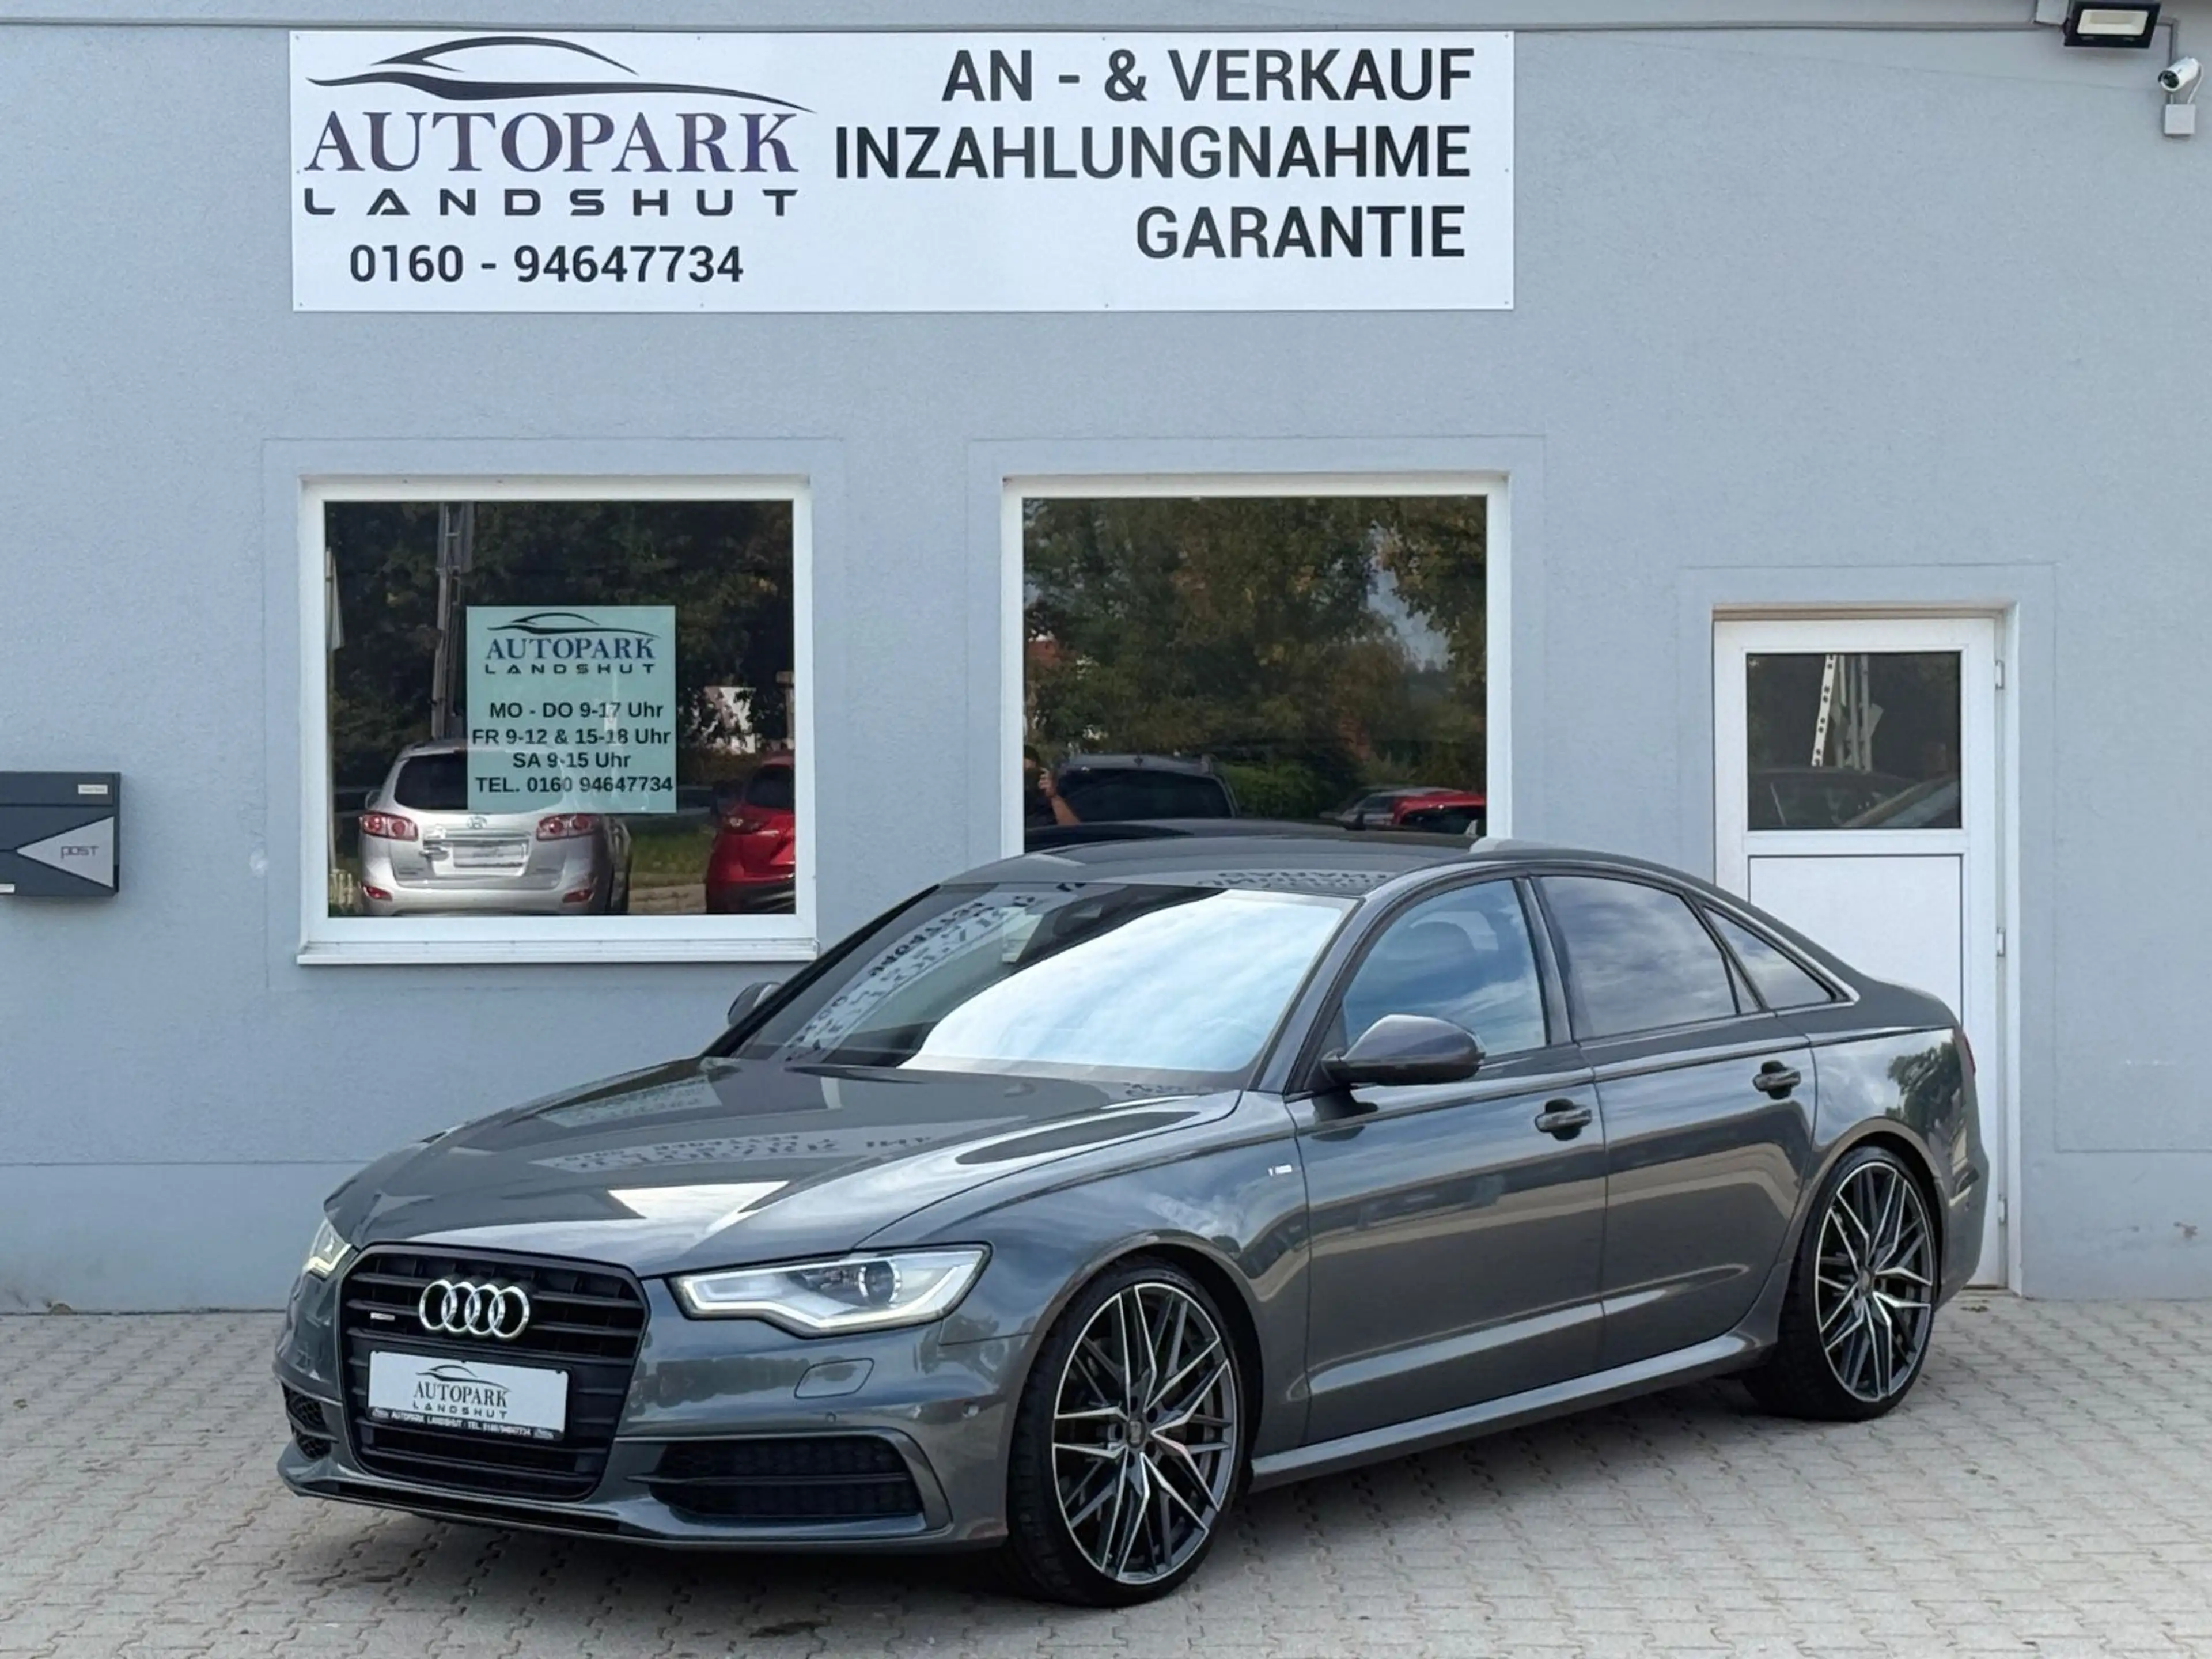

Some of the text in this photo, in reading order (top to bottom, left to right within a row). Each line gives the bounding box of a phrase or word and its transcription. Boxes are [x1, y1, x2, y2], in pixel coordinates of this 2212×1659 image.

[942, 48, 1475, 102] AN - & VERKAUF
[304, 110, 800, 173] AUTOPARK
[836, 125, 1471, 179] INZAHLUNGNAHME
[304, 188, 798, 217] LANDSHUT
[1137, 205, 1465, 259] GARANTIE
[350, 244, 744, 283] 0160 - 94647734
[486, 638, 656, 660] AUTOPARK
[485, 664, 655, 675] LANDSHUT
[490, 702, 522, 718] MO
[543, 703, 573, 718] DO
[579, 702, 621, 718] 9-17
[628, 702, 664, 718] Uhr
[472, 729, 671, 745] FR 9-12 & 15-18 Uhr
[513, 752, 631, 768] SA 9-15 Uhr
[476, 777, 673, 793] TEL. 0160 94647734
[414, 1381, 507, 1407] AUTOPARK
[412, 1400, 508, 1419] LANDSHUT
